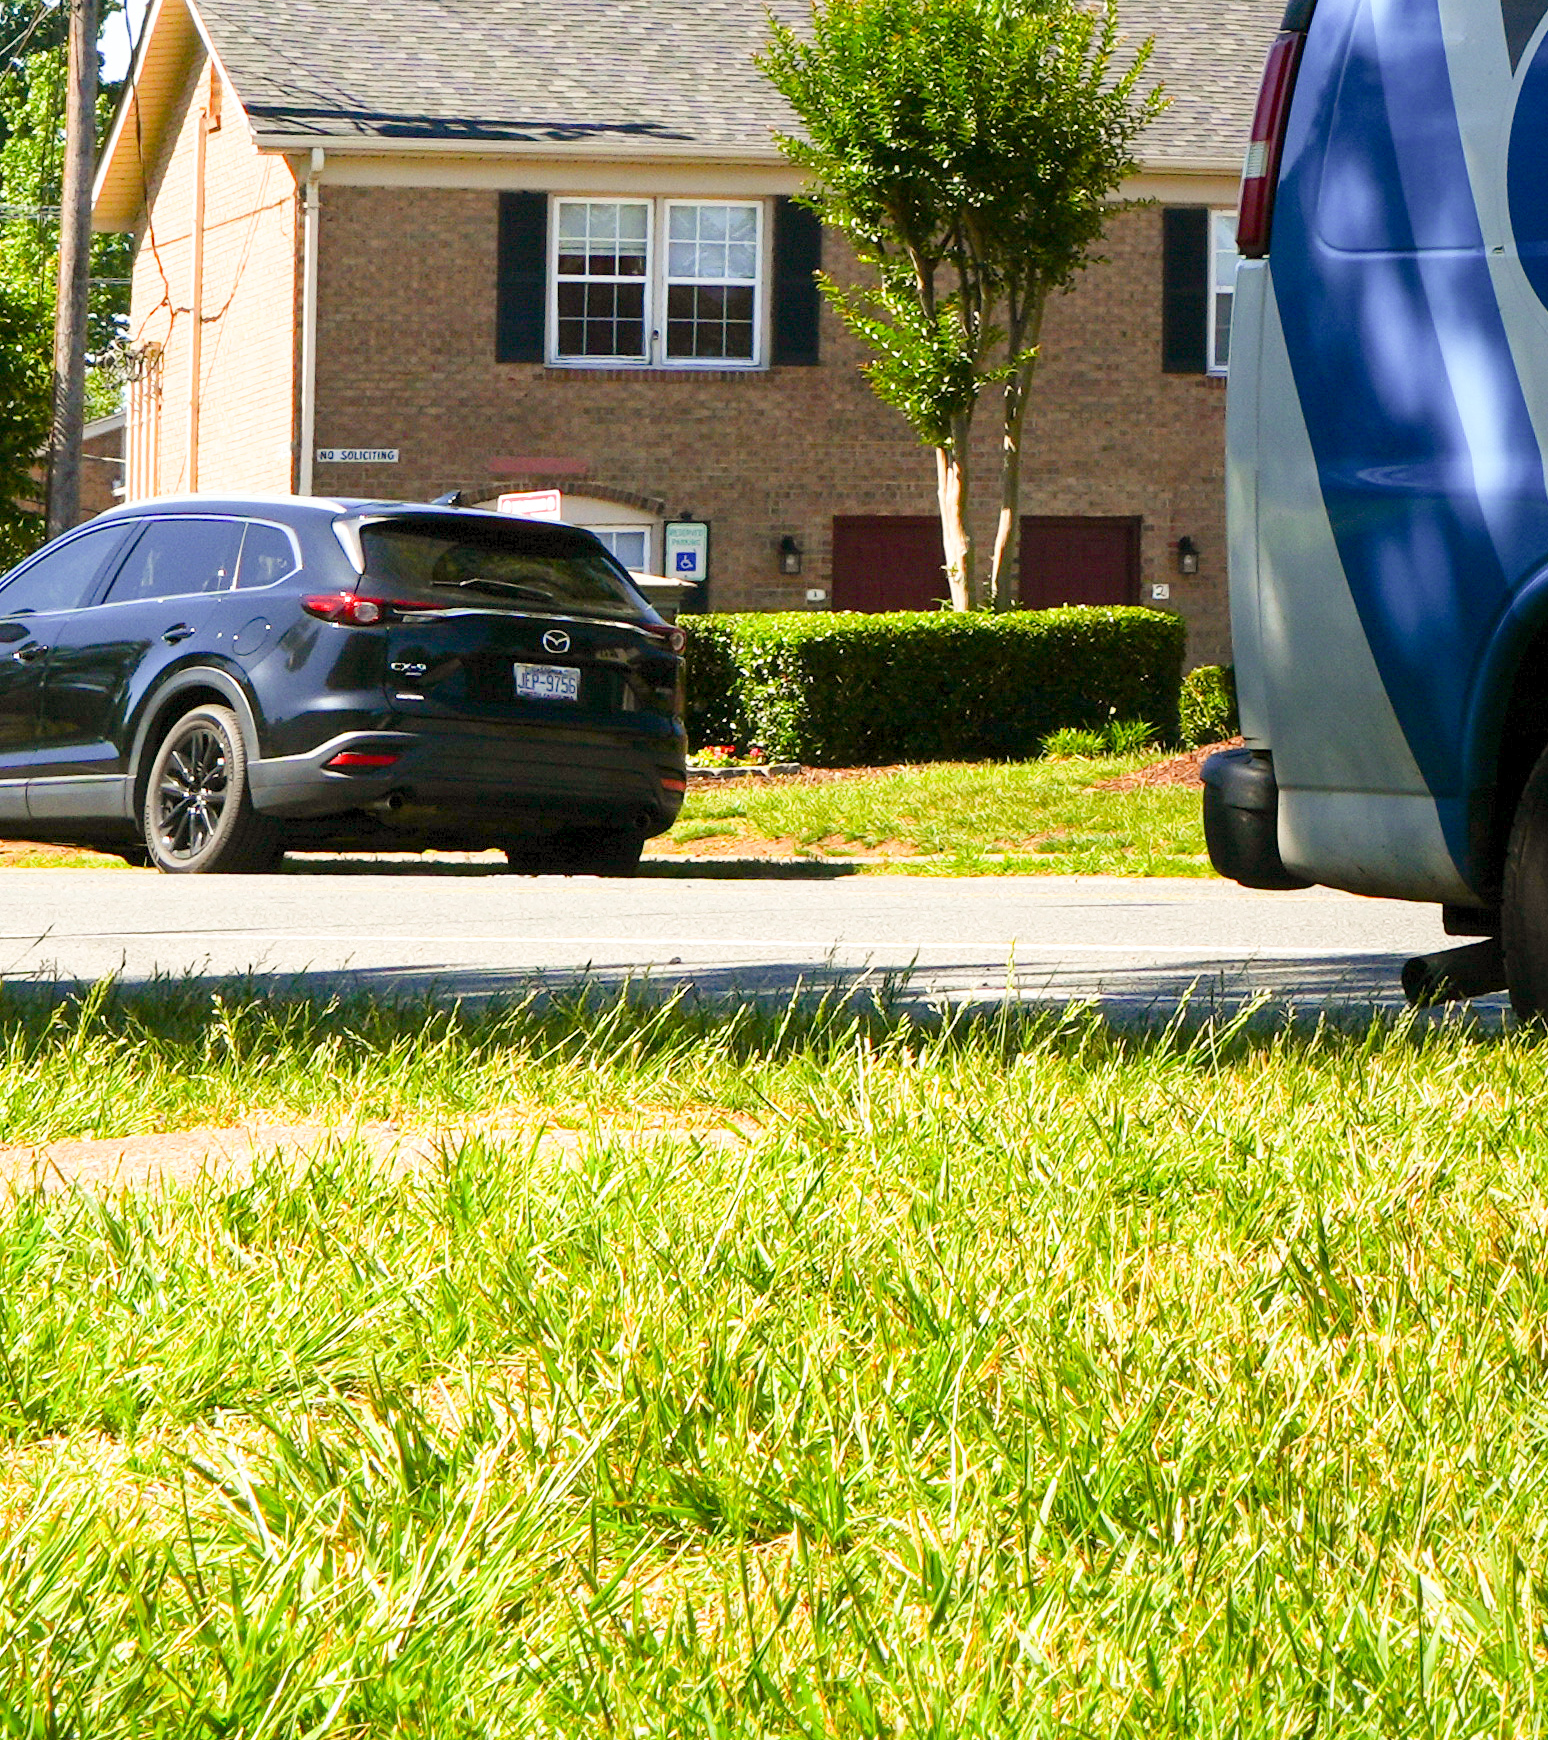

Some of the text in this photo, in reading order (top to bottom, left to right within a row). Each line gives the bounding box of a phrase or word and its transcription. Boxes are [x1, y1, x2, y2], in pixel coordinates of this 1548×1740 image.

[320, 450, 395, 460] NO SOLICITING
[1156, 585, 1166, 597] 2
[518, 671, 576, 694] JEP-9756
